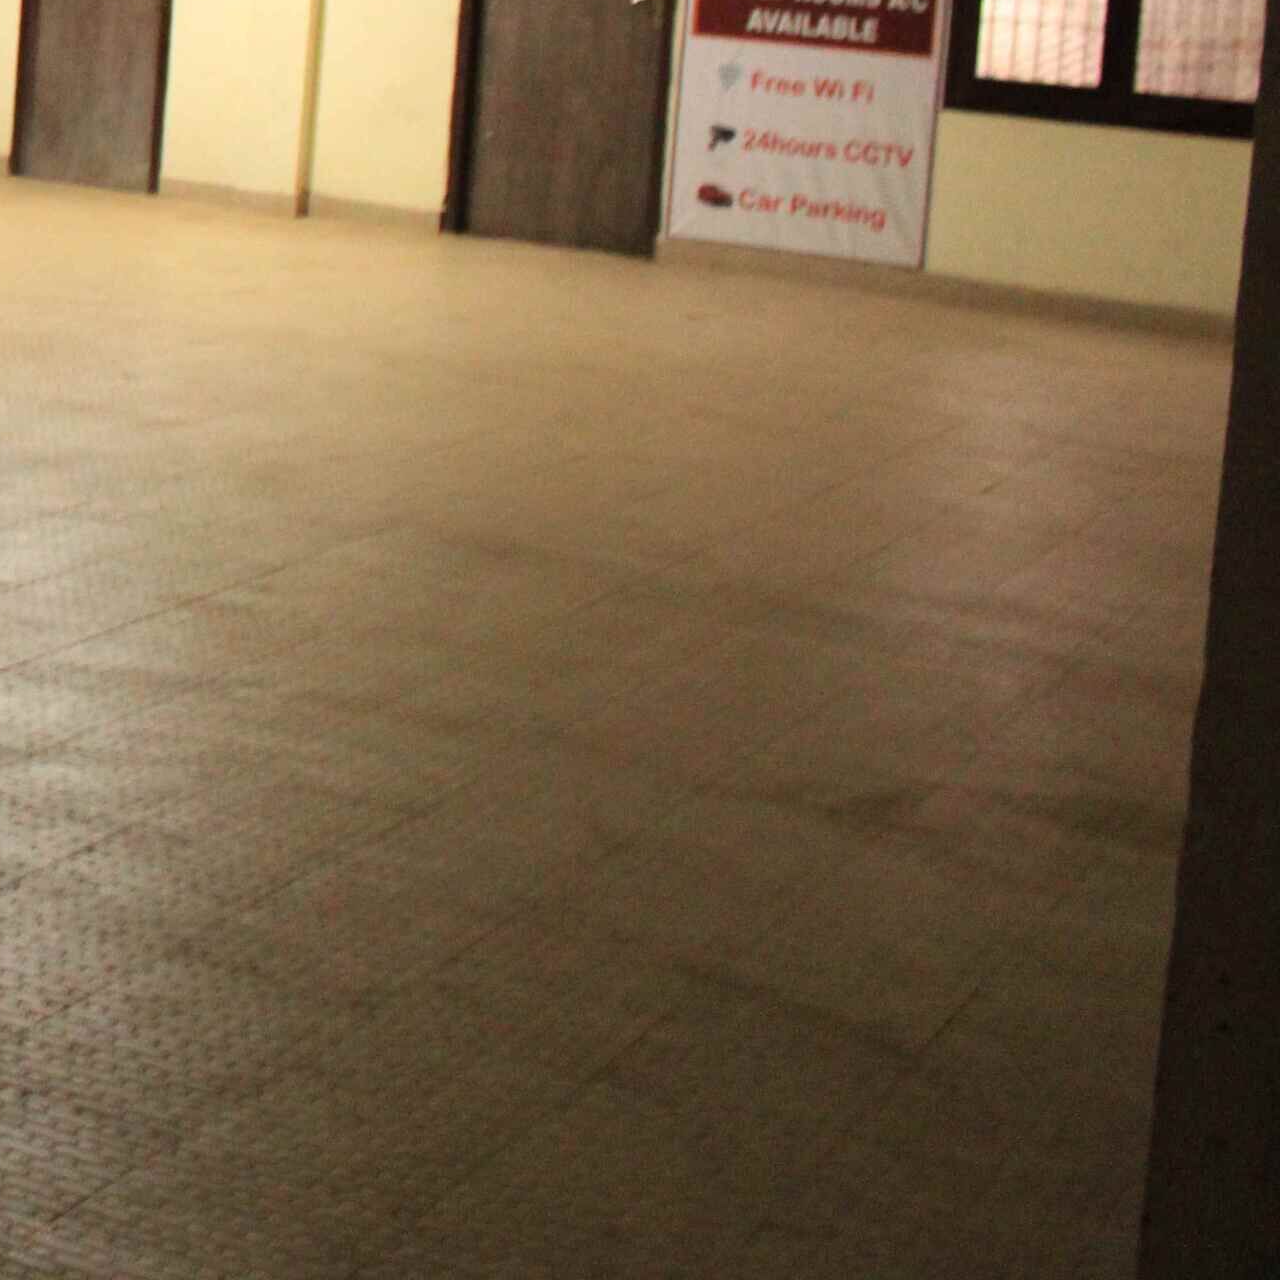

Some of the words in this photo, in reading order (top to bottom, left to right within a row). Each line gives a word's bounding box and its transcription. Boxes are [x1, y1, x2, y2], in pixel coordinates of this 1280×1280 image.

[746, 9, 880, 43] AVAILABLE
[750, 70, 806, 97] Free
[742, 128, 837, 160] 24hours
[843, 140, 915, 168] CCTV
[739, 188, 783, 213] Car
[788, 193, 888, 233] Parking
